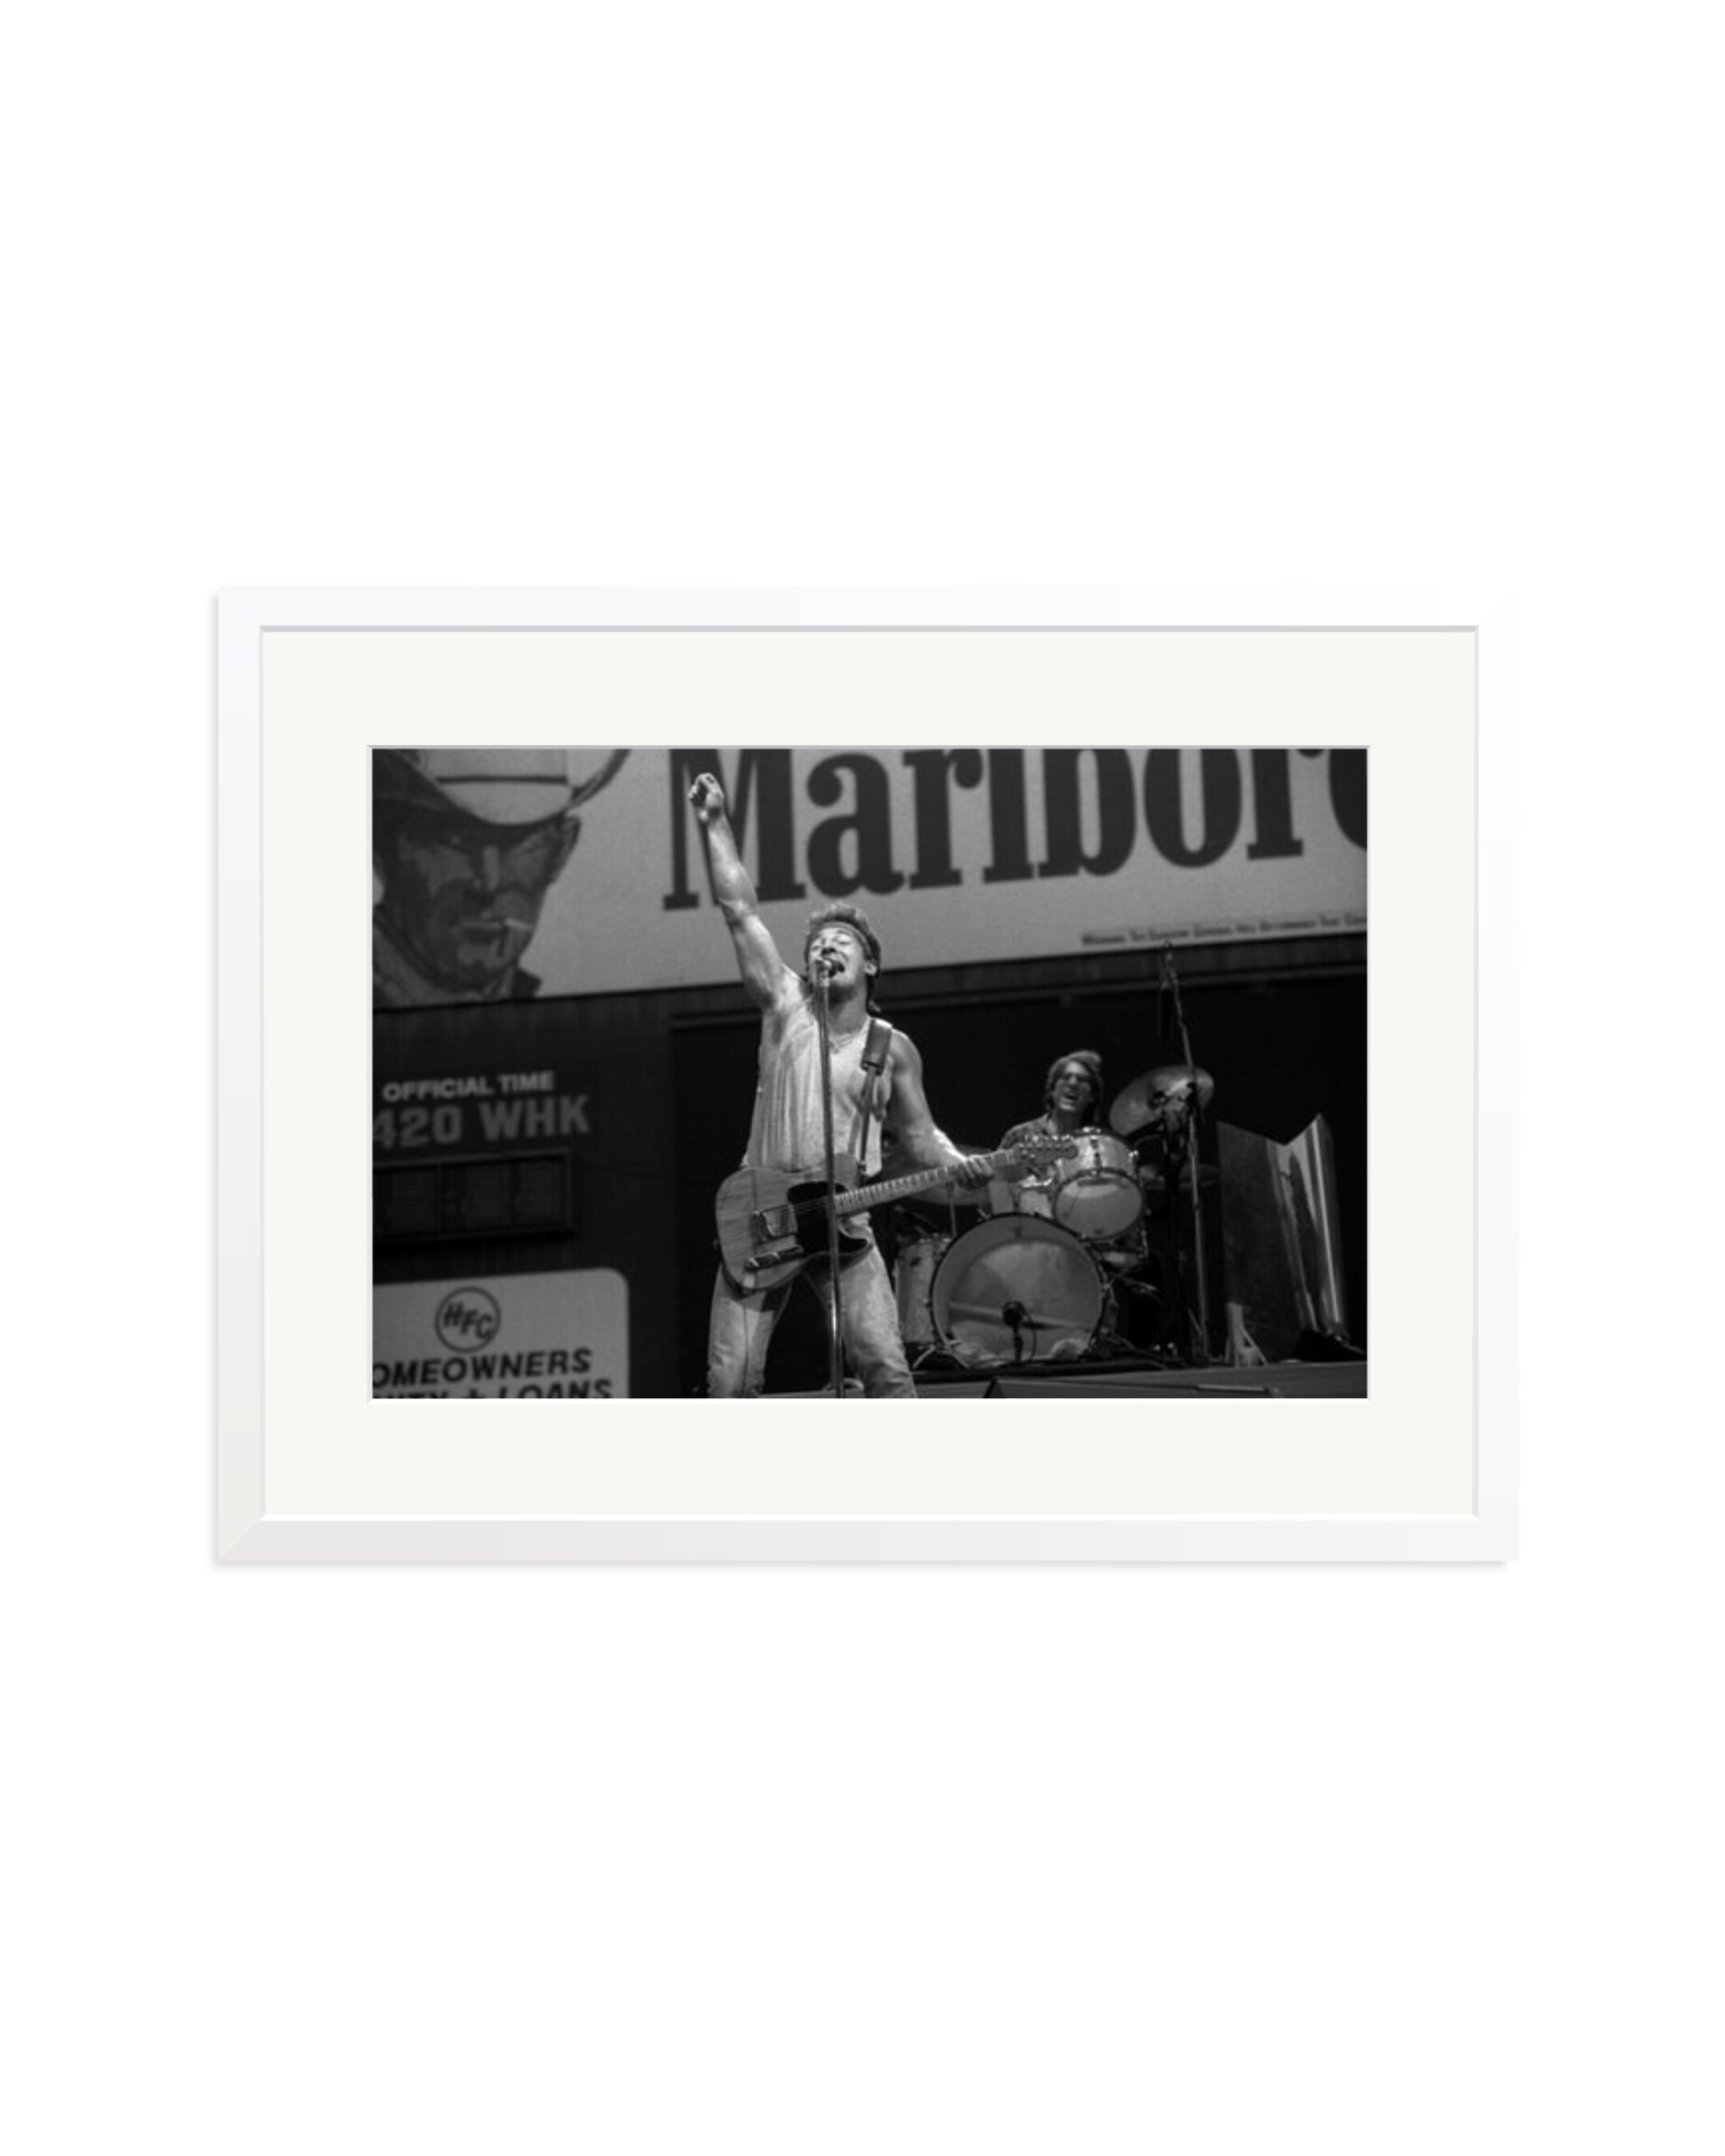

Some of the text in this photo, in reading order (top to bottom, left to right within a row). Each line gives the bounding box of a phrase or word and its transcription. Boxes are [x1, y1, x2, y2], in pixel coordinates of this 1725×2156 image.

[662, 749, 1368, 910] Marlbor
[382, 1070, 554, 1103] OFFICIAL TIME
[477, 1094, 590, 1141] WHK
[442, 1300, 494, 1340] HFC
